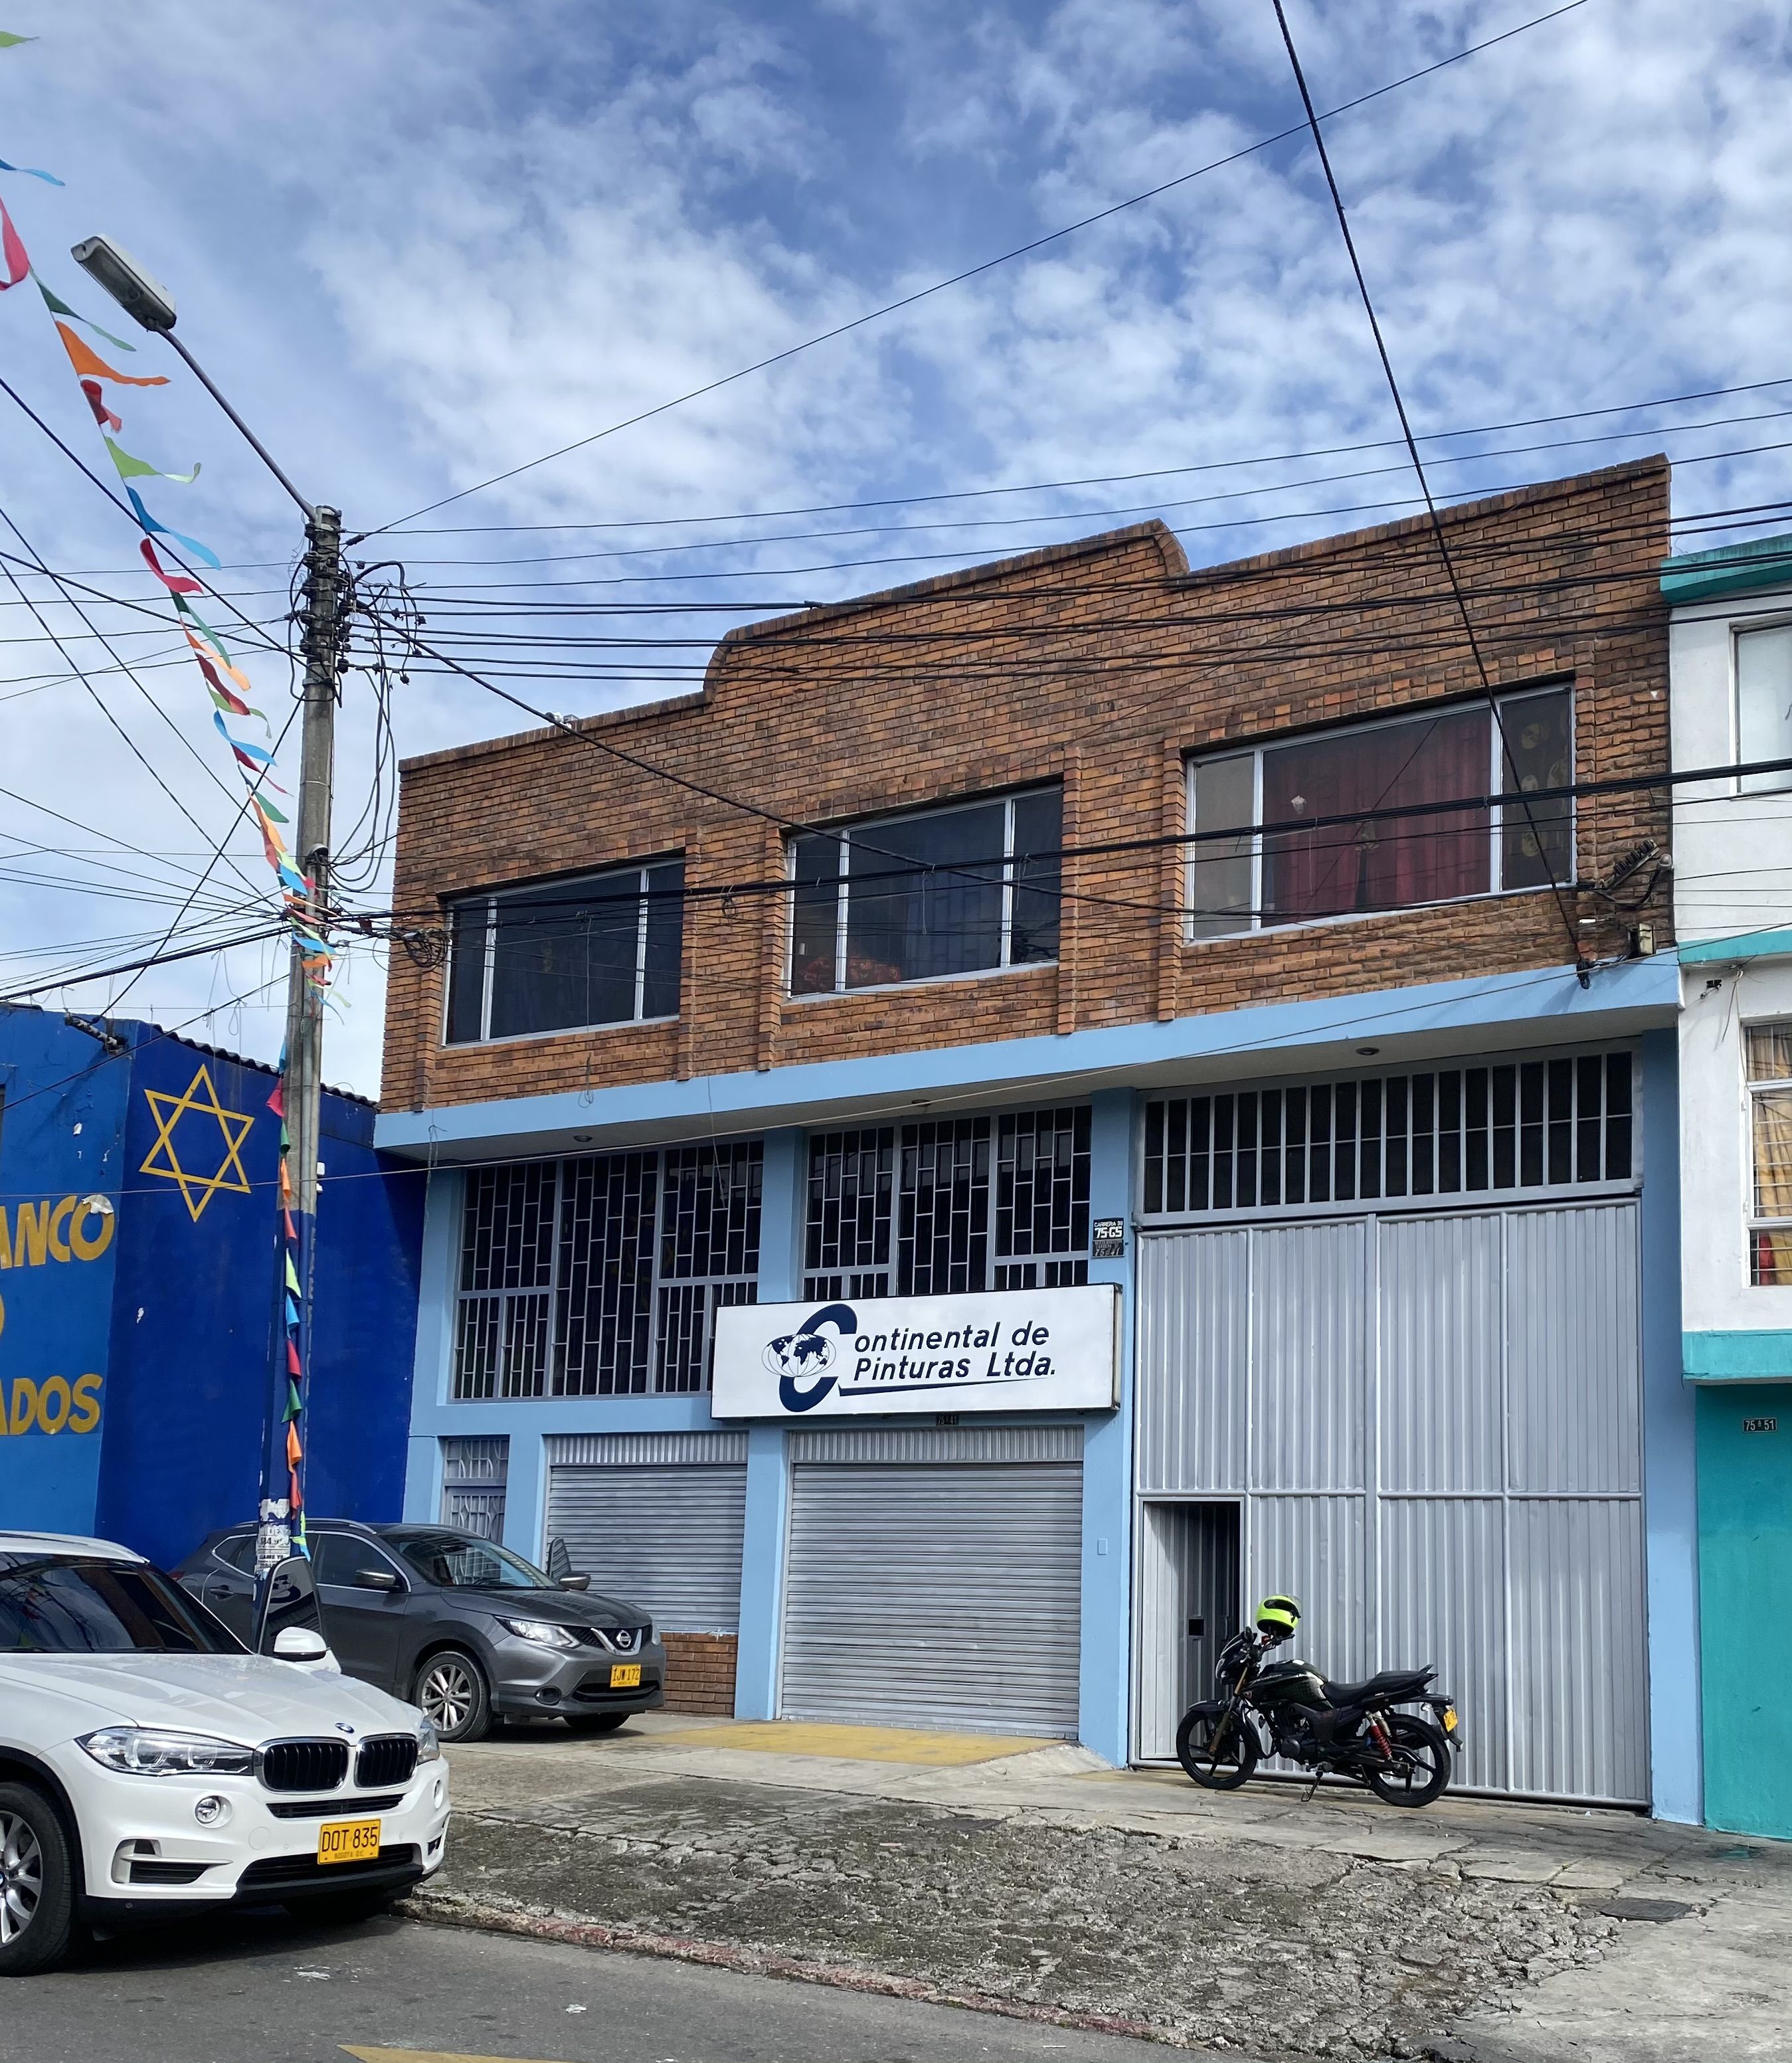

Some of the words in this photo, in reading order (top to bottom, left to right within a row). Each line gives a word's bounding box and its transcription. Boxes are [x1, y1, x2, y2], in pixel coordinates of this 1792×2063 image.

[1012, 1320, 1049, 1346] de
[854, 1355, 970, 1381] Pinturas
[986, 1350, 1055, 1377] Ltda.
[0, 1374, 103, 1435] DOS
[627, 1668, 640, 1680] 172
[322, 1829, 349, 1852] DOT
[353, 1827, 378, 1848] 835
